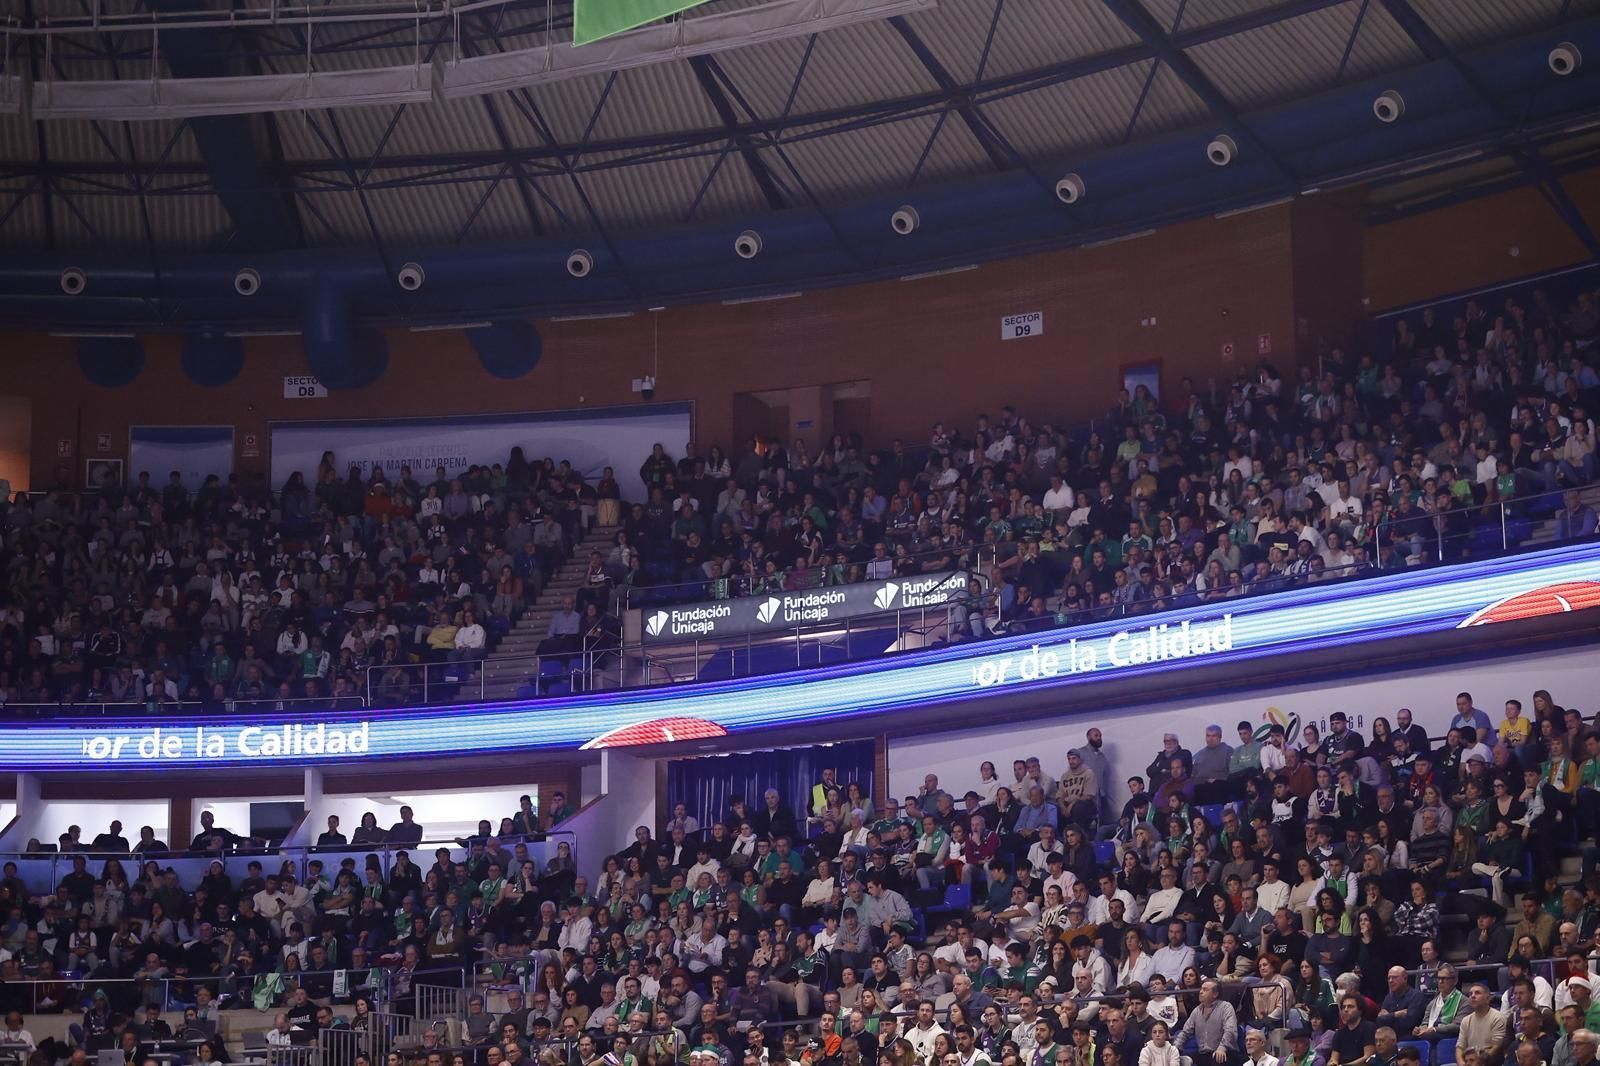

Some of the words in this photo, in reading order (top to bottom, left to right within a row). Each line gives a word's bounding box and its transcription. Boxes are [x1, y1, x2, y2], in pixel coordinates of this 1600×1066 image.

[1004, 313, 1040, 326] SECTOR
[1015, 325, 1031, 336] D9
[287, 377, 319, 386] SECTO
[298, 387, 315, 397] D8
[902, 576, 966, 594] Fundación
[784, 591, 845, 609] Fundación
[902, 591, 948, 607] Unicaja
[672, 605, 730, 622] Fundación
[784, 606, 828, 622] Unicaja
[672, 619, 714, 635] Unicaja
[1020, 644, 1058, 680] de
[1070, 638, 1097, 673] la
[1108, 613, 1232, 667] Calidad
[139, 728, 183, 758] de
[197, 726, 224, 758] la
[238, 722, 368, 757] Calidad
